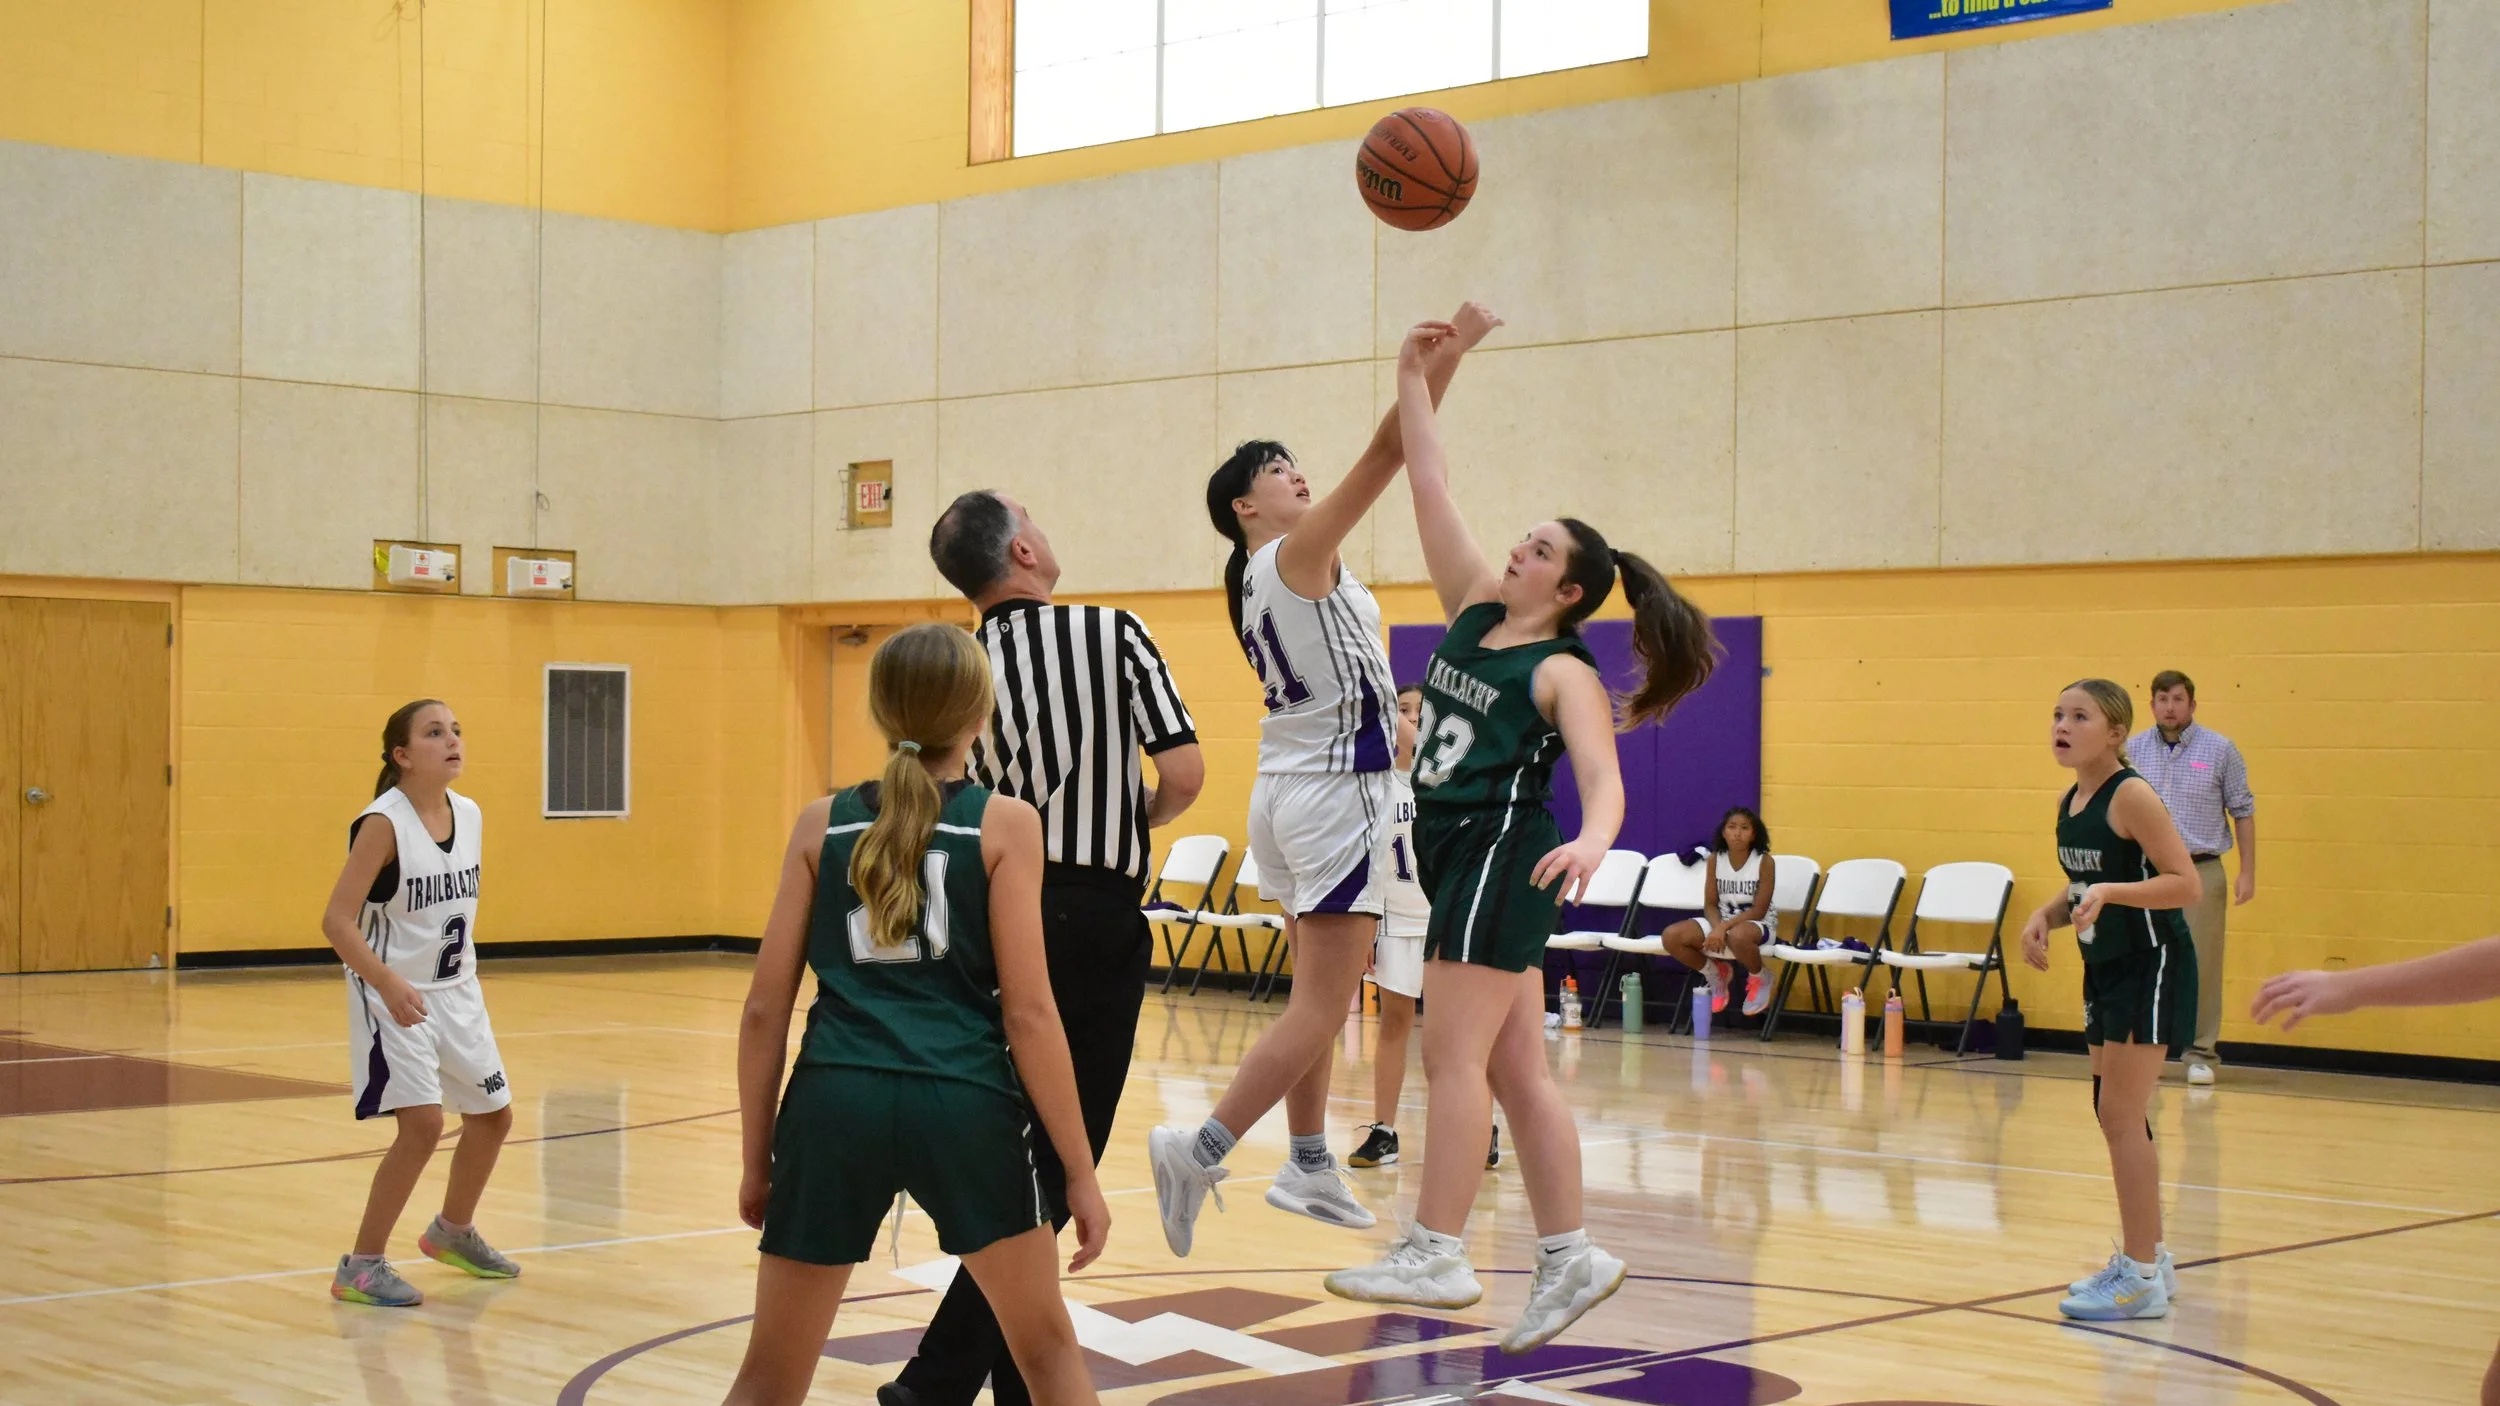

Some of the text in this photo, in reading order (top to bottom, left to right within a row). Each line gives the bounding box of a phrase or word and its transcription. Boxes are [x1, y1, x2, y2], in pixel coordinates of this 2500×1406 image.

[1358, 161, 1402, 201] Wils
[861, 483, 882, 509] EXIT
[1428, 657, 1501, 717] MALACHY
[406, 863, 480, 913] TRAILBLAZ
[432, 912, 468, 982] 2
[478, 1070, 505, 1095] NGS
